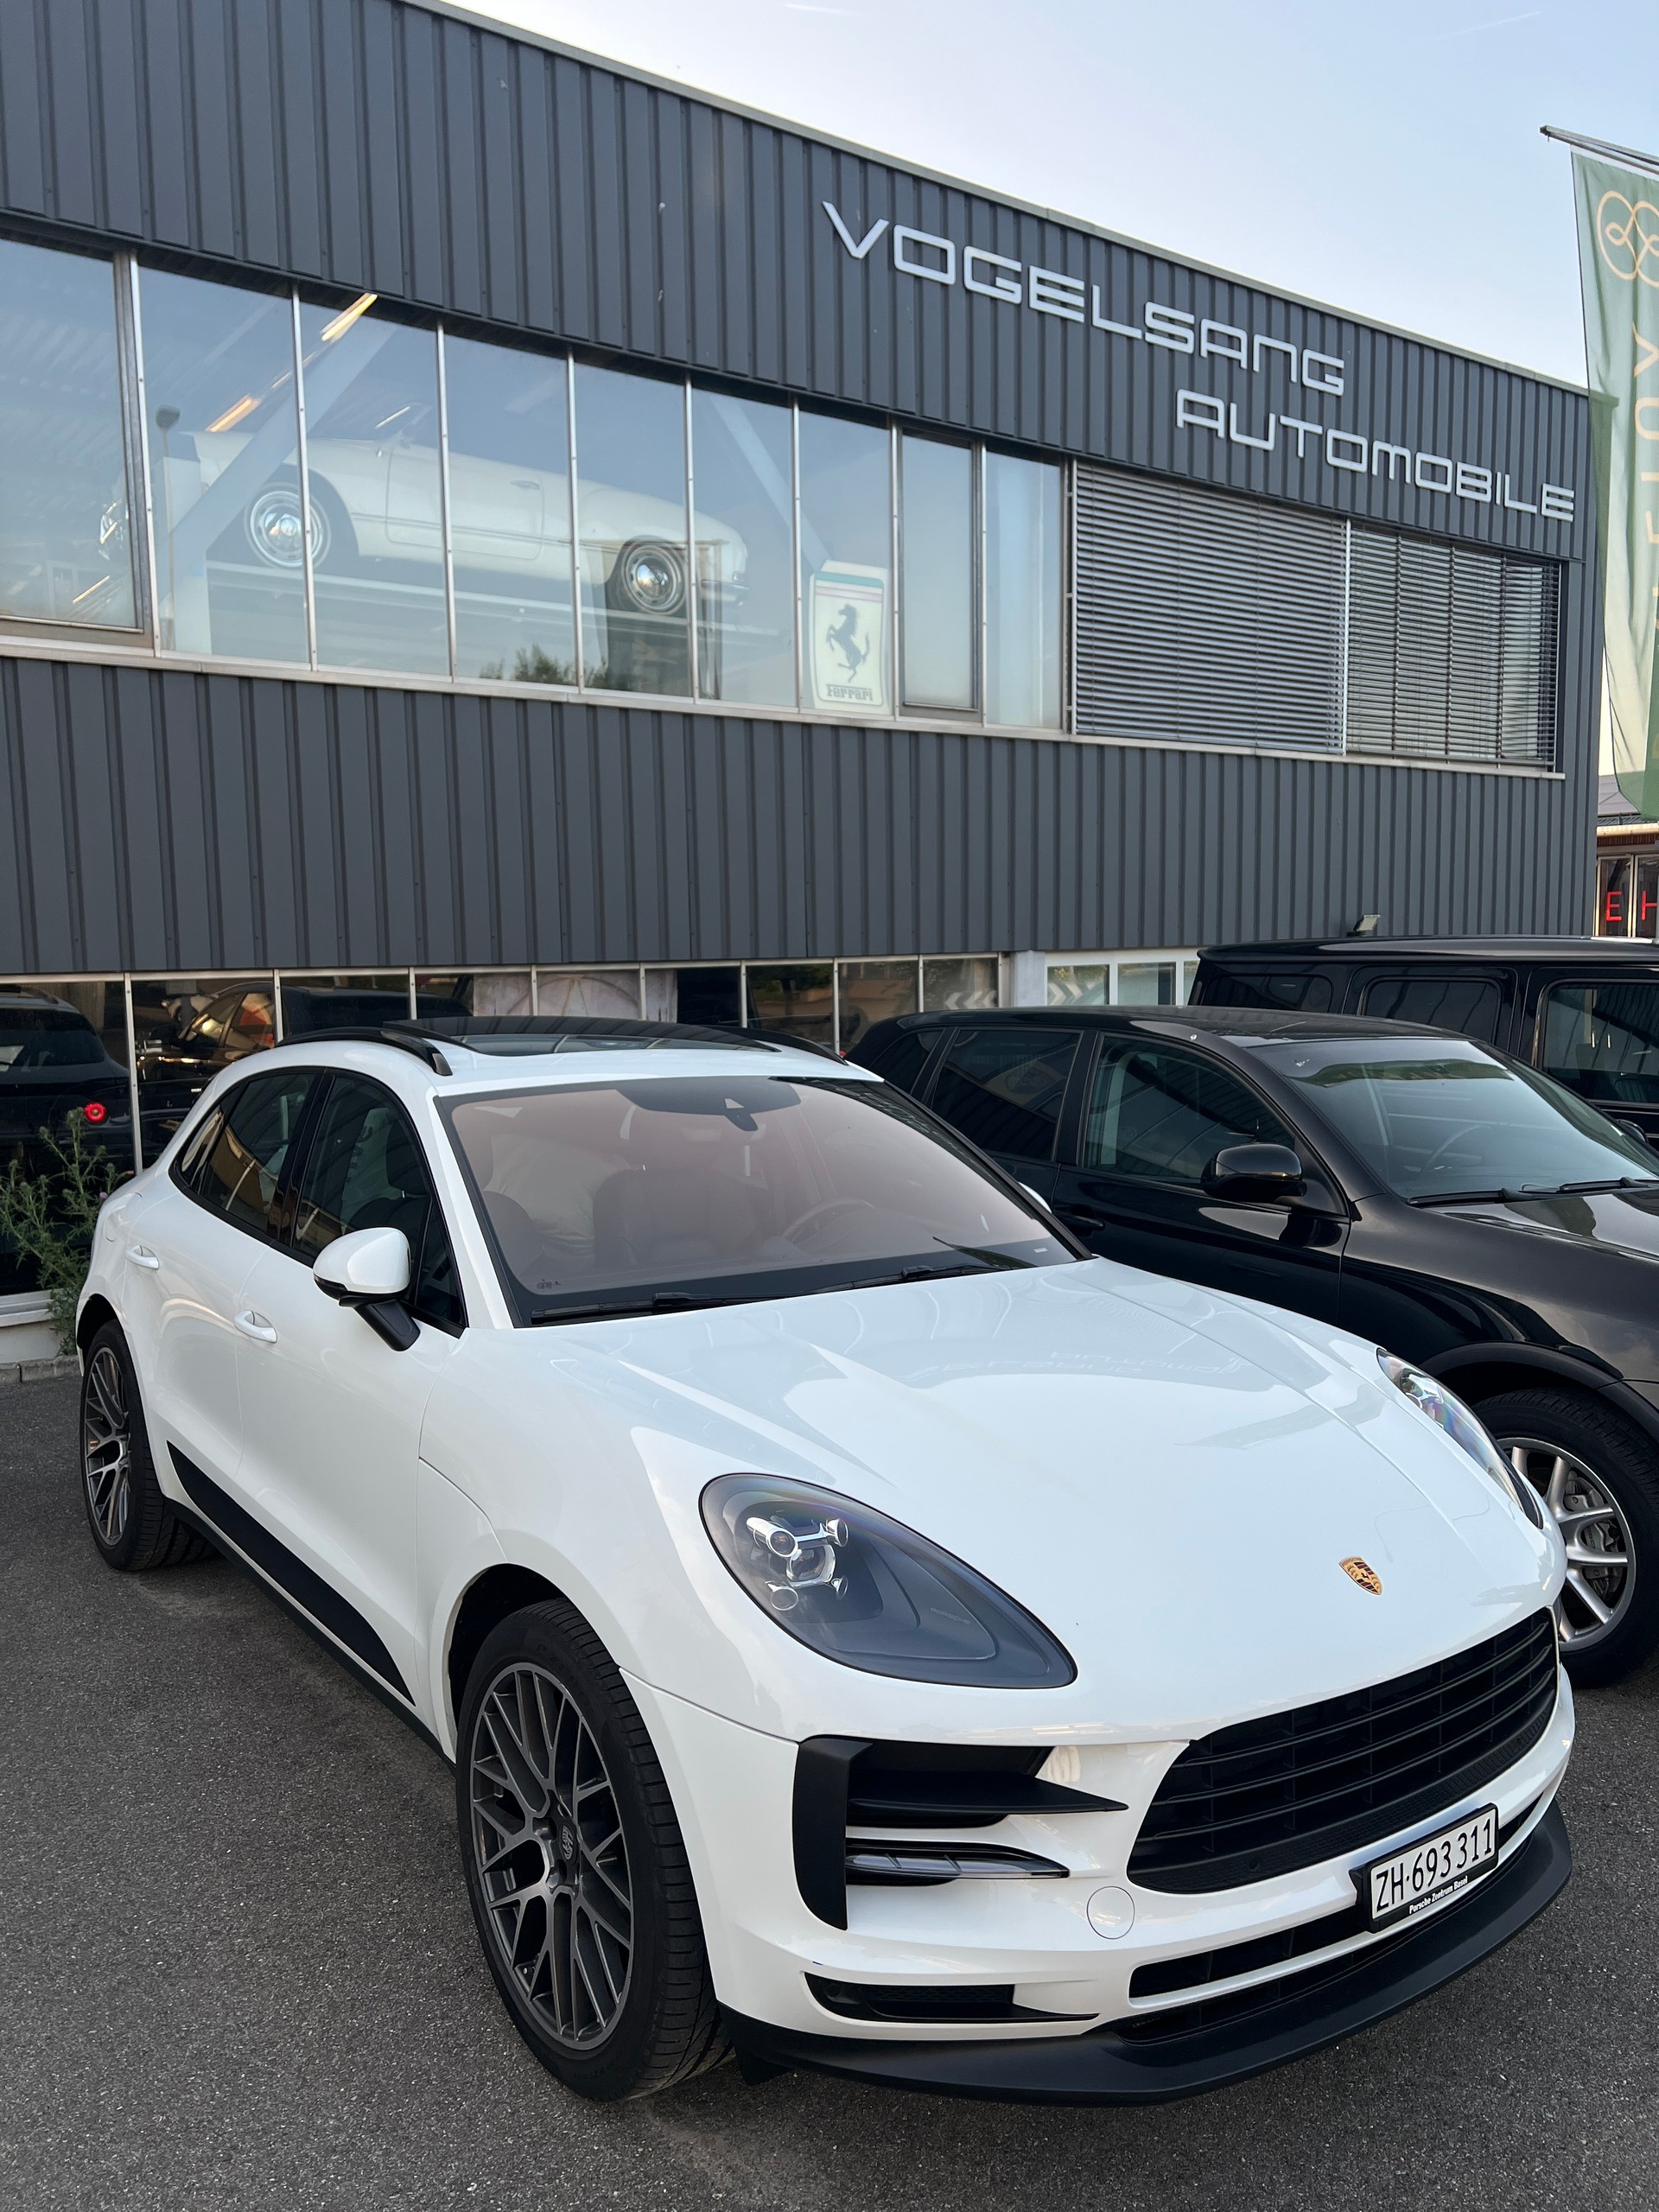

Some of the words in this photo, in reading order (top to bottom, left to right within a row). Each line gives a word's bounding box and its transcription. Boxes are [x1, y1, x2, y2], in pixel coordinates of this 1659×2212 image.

[823, 200, 1344, 397] VOGELSANG
[1176, 388, 1575, 524] AUTOMOBILE
[826, 683, 874, 701] Ferrari
[1408, 1897, 1432, 1915] Porsche
[1431, 1885, 1453, 1903] Zentrum
[1453, 1874, 1468, 1891] Basel
